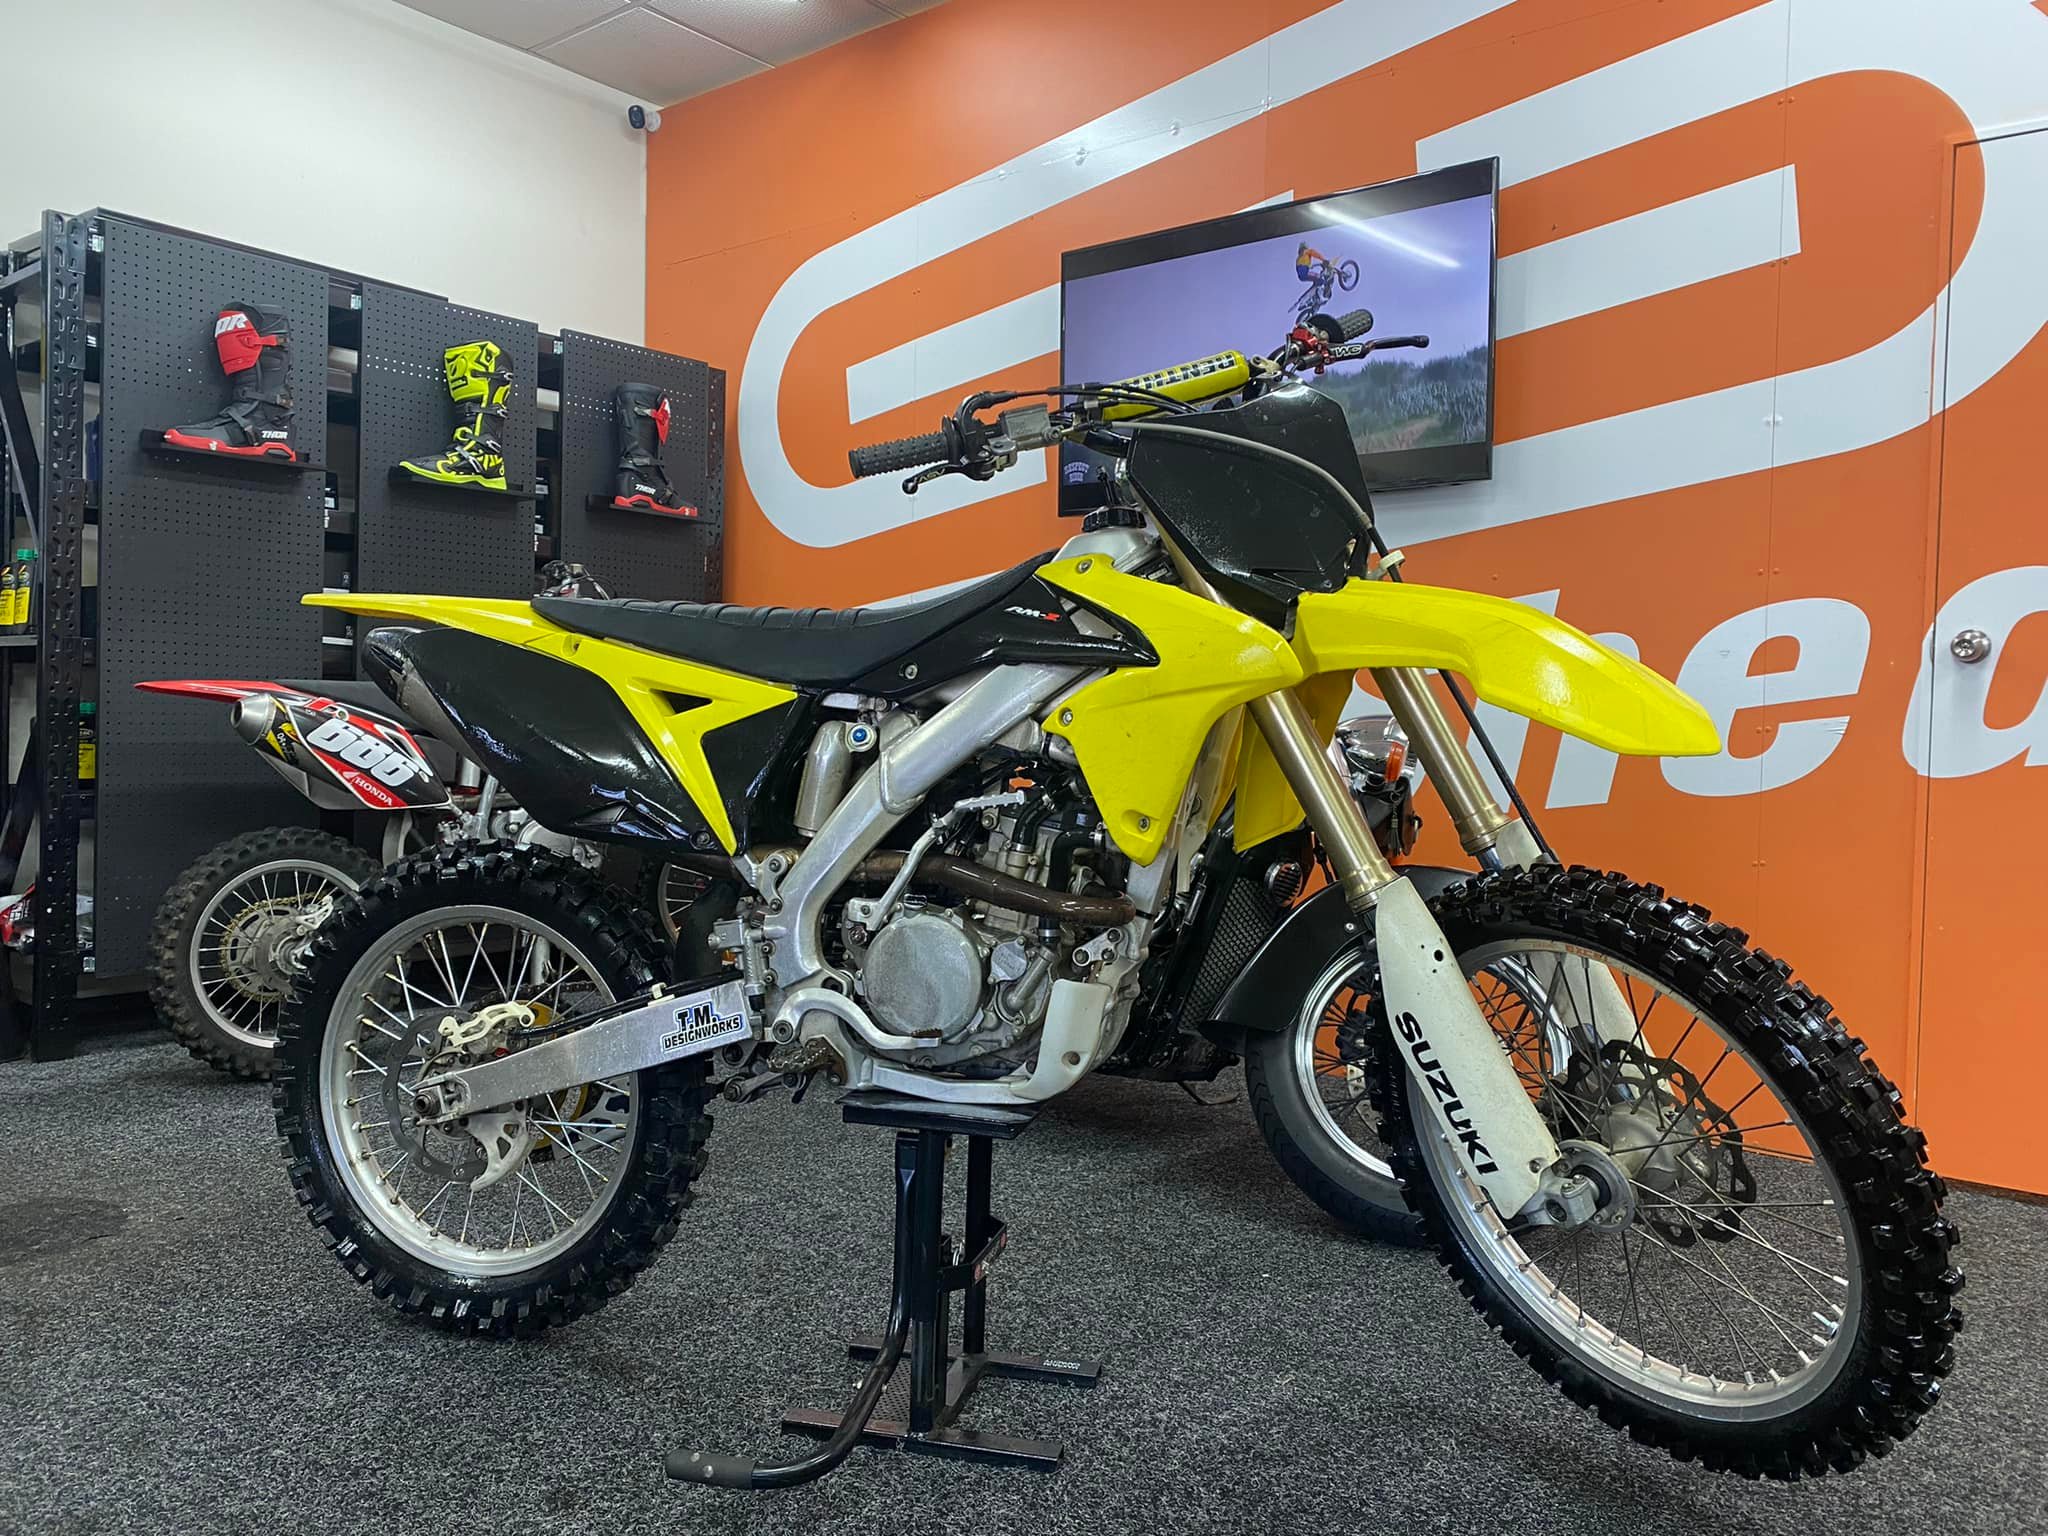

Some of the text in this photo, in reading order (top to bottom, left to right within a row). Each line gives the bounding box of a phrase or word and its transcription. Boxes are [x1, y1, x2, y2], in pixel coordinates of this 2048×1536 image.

[261, 430, 289, 439] THOR
[634, 483, 657, 496] THOR
[306, 718, 420, 787] 686
[354, 777, 393, 806] HONDA
[664, 1017, 740, 1049] DESIGNWORKS
[677, 1005, 717, 1032] T.M.
[1394, 1011, 1500, 1176] SUZUKI
